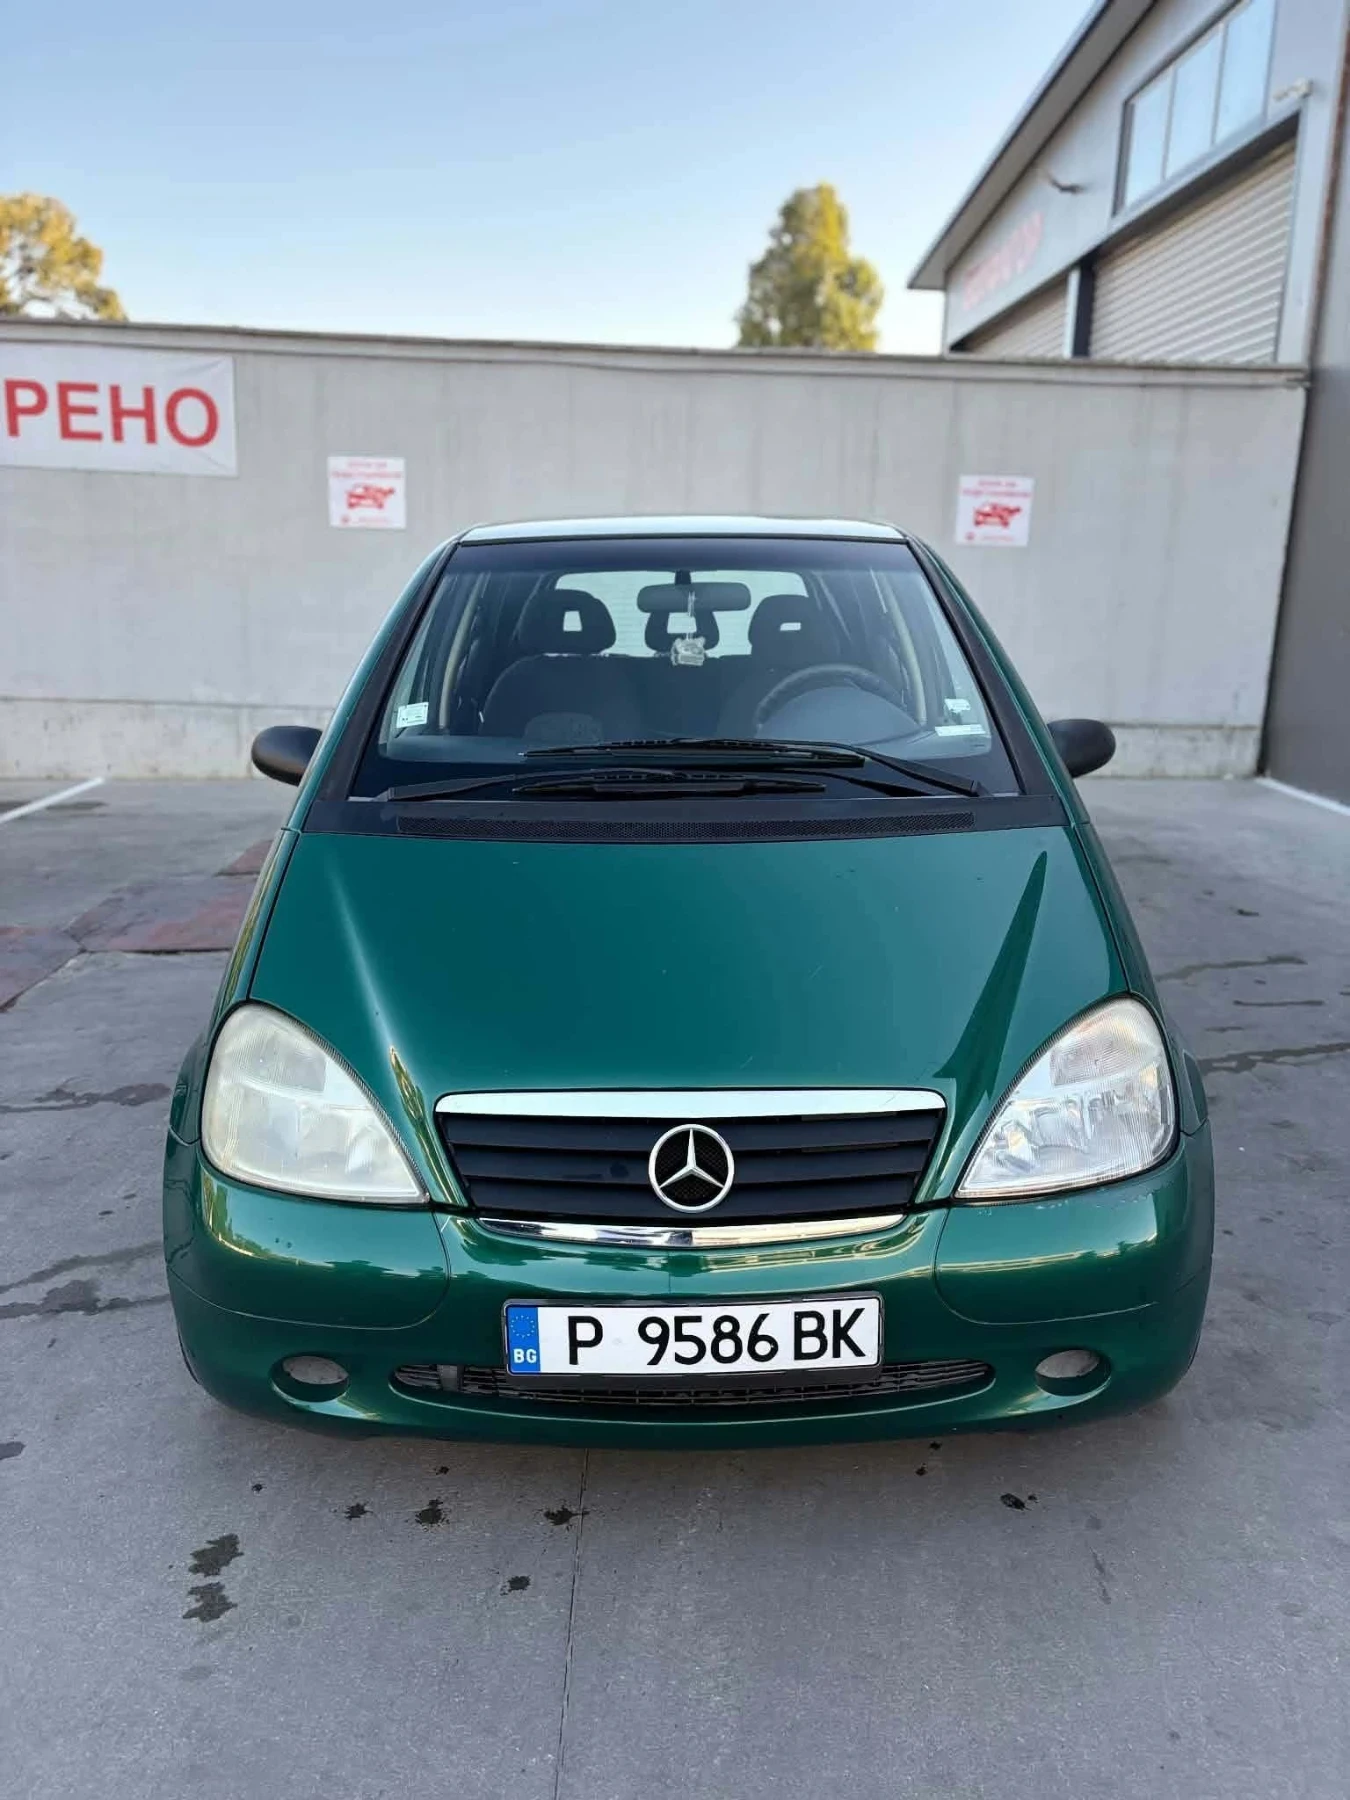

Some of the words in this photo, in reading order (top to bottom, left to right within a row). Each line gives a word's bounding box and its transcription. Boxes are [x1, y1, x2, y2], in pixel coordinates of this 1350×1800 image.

[4, 378, 219, 447] РЕНО
[513, 1349, 537, 1364] BG
[567, 1315, 603, 1365] P
[637, 1313, 779, 1366] 9586
[793, 1307, 866, 1361] BK
